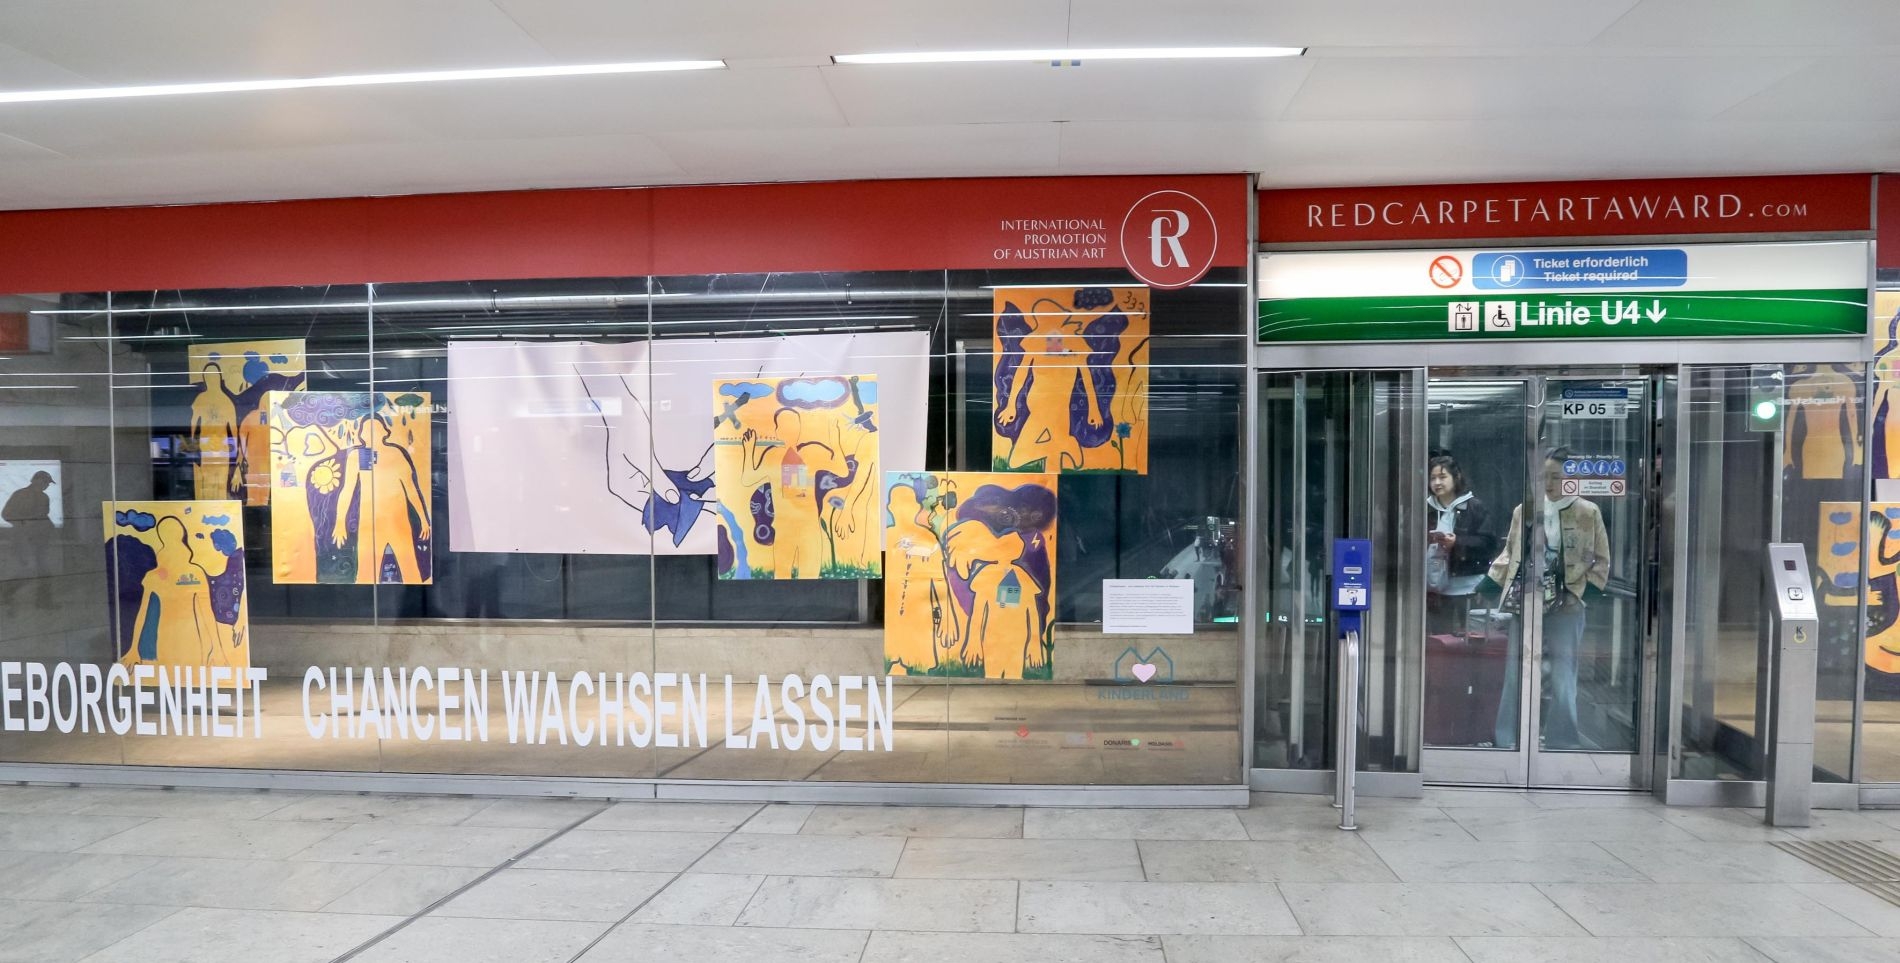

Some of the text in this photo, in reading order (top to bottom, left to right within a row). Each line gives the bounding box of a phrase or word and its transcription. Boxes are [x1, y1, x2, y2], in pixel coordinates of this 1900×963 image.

[1001, 219, 1106, 231] INTERNATIONAL
[1024, 233, 1107, 245] PROMOTION
[993, 247, 1107, 260] OF AUSTRIAN ART
[1533, 256, 1649, 269] Ticket erforderlich
[1544, 270, 1638, 283] Ticket required
[1521, 300, 1640, 326] Linie U4
[1563, 403, 1606, 415] KP 05
[1098, 687, 1190, 700] KINDERLAND
[1, 661, 893, 751] EBORGENHEIT CHANCEN WACHSEN LASSEN
